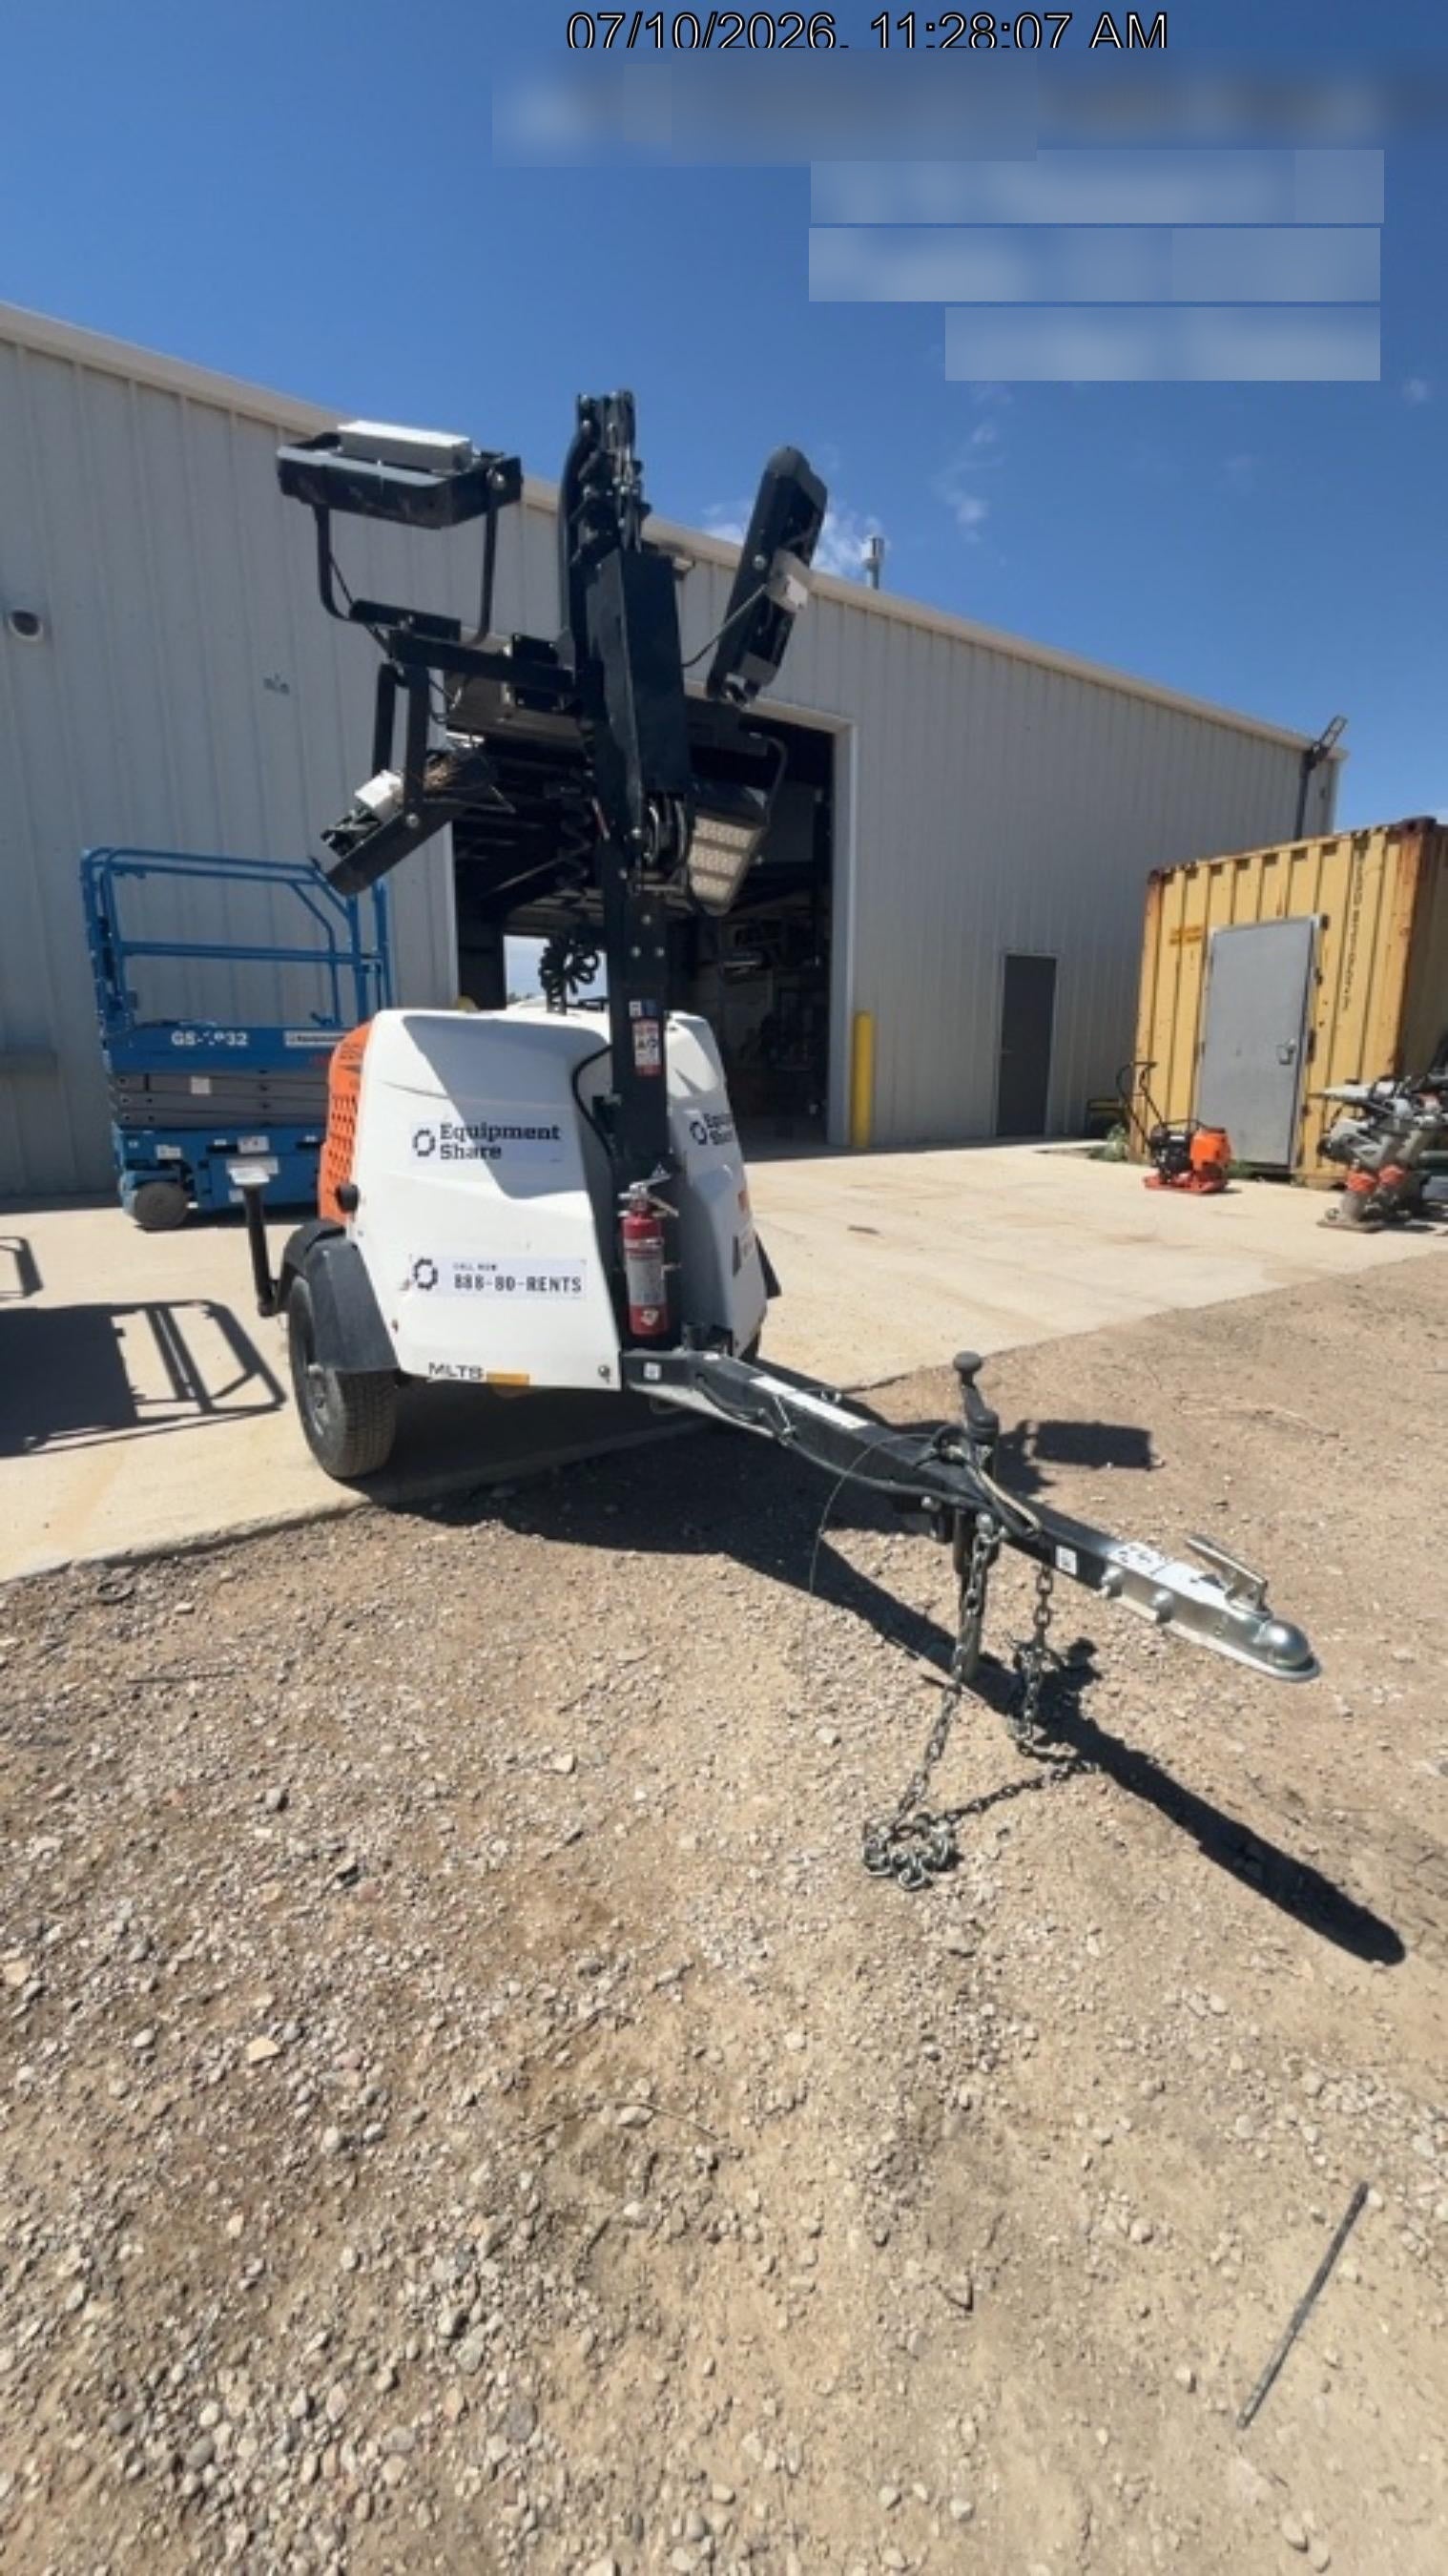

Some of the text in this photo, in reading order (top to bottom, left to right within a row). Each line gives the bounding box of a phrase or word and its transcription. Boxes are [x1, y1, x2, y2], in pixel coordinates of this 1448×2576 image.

[440, 1122, 561, 1143] Equipment
[440, 1144, 502, 1159] Share
[454, 1274, 583, 1293] 888-80-RENTS
